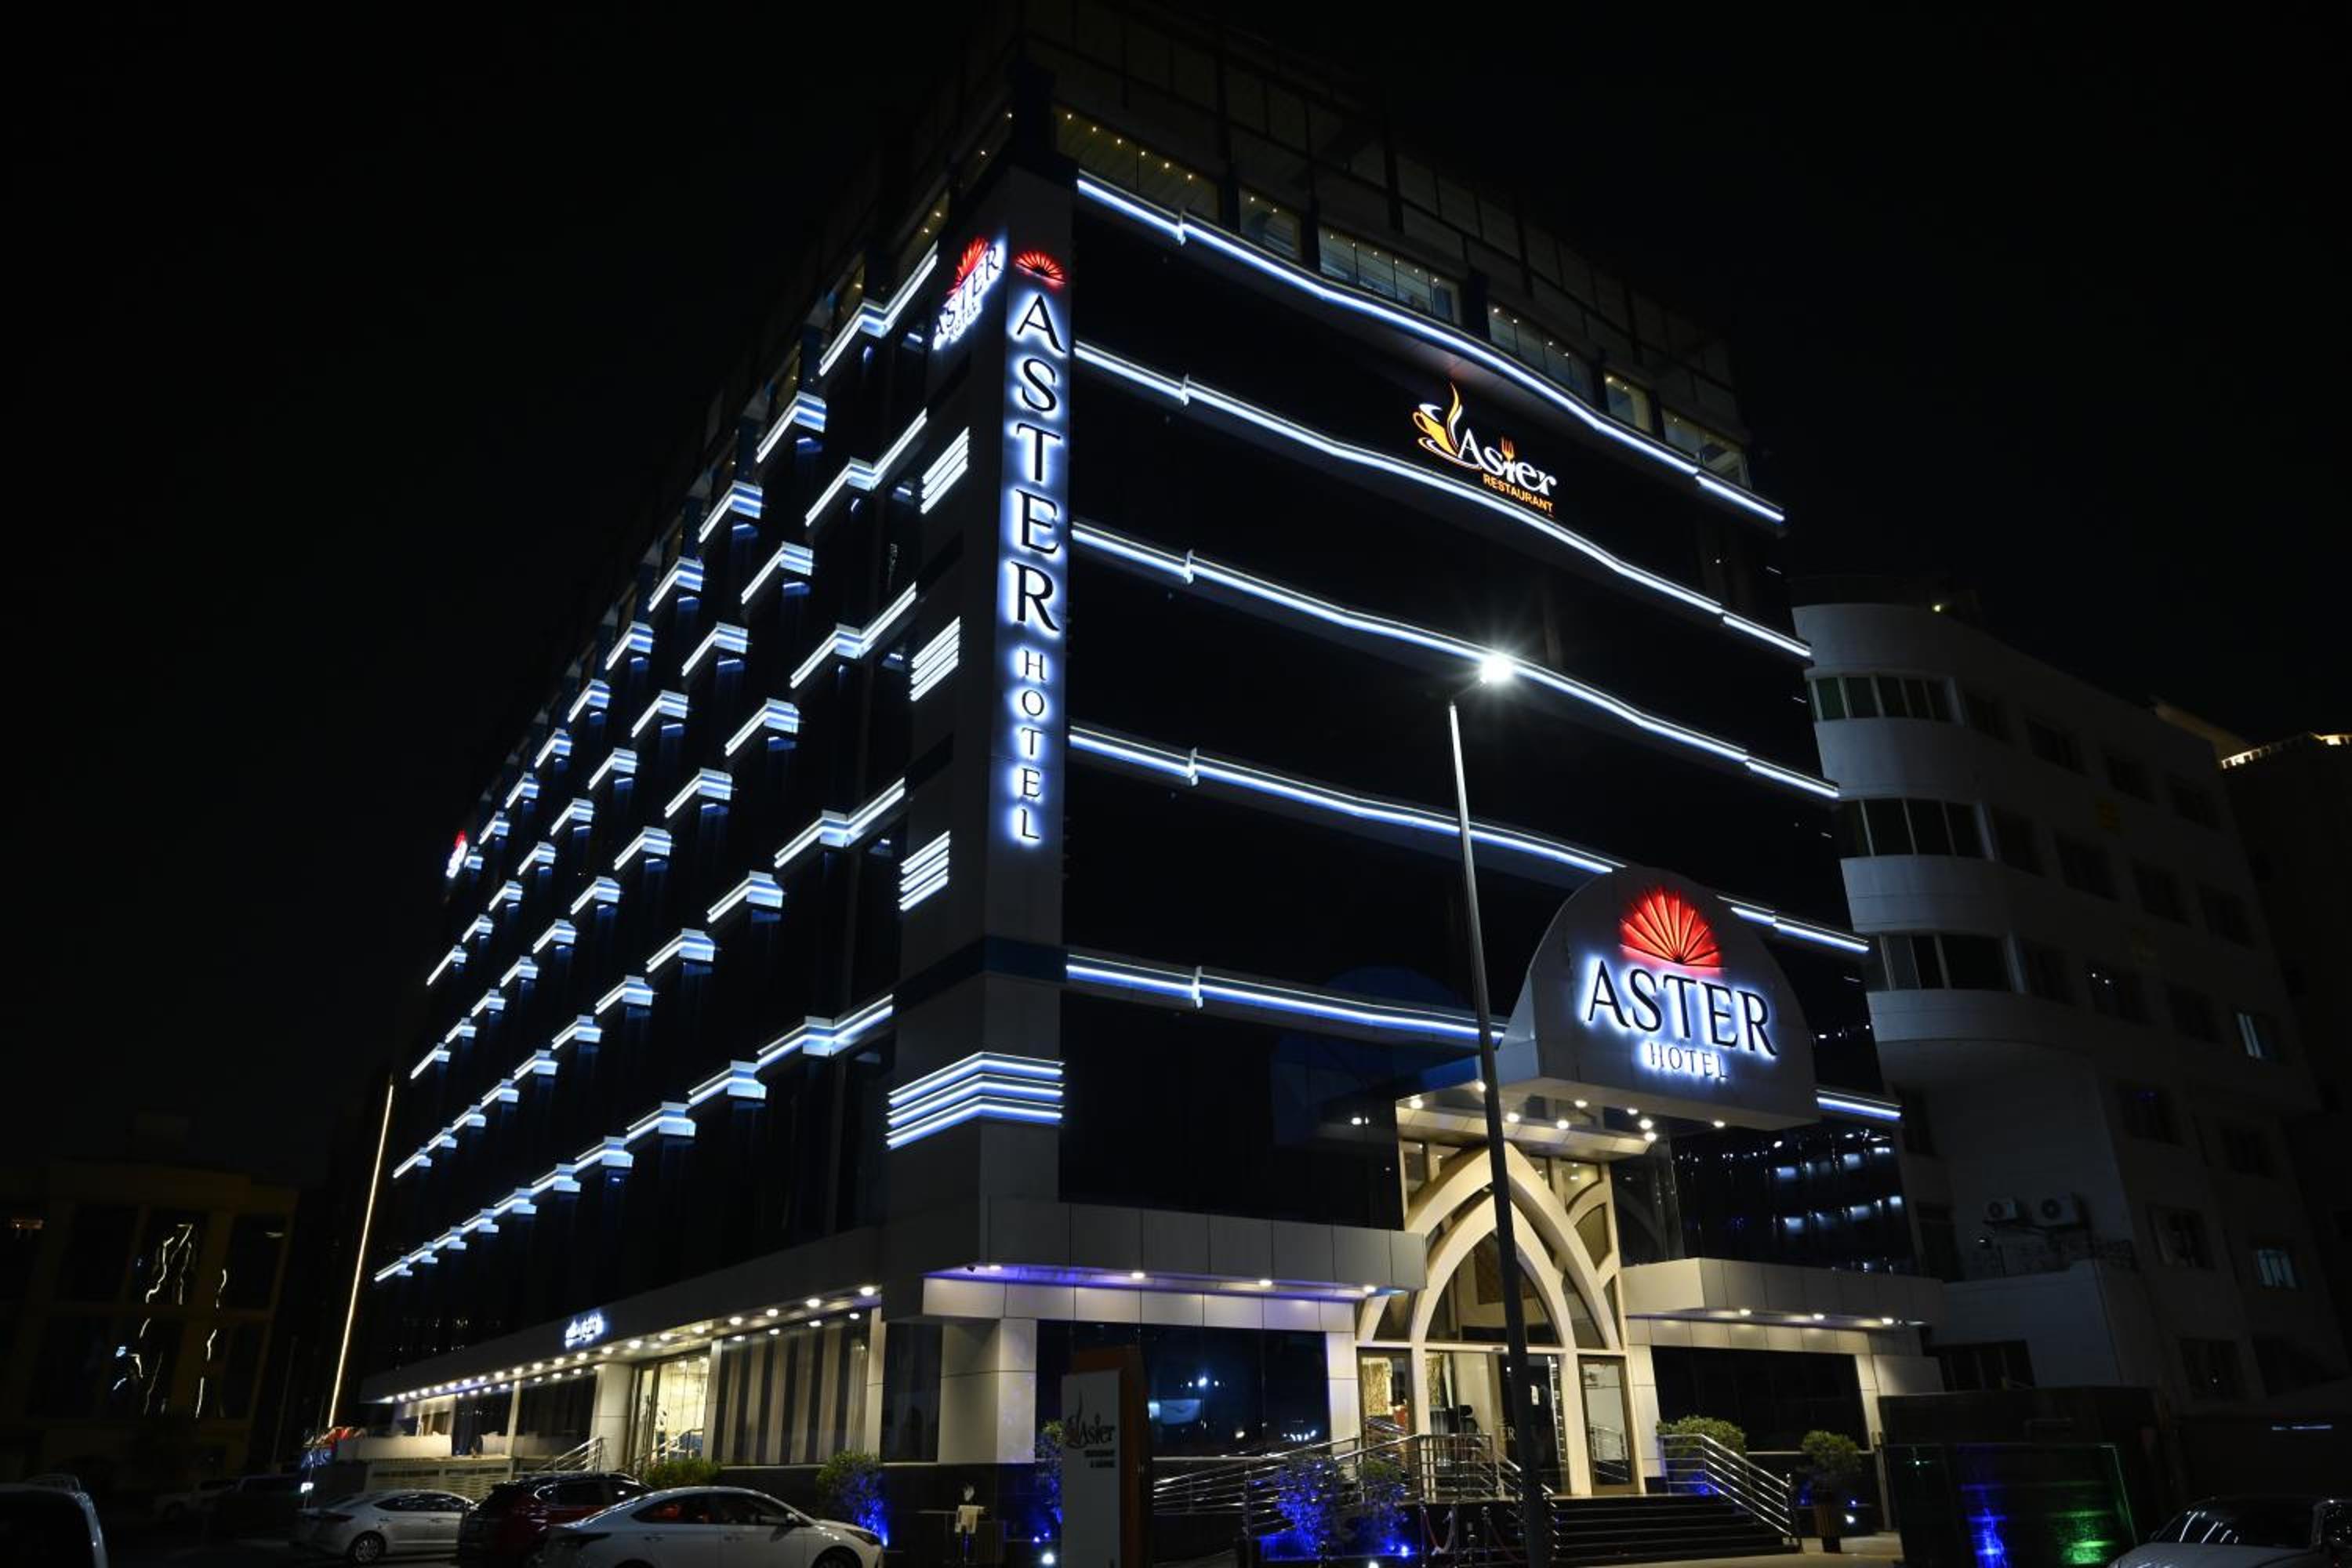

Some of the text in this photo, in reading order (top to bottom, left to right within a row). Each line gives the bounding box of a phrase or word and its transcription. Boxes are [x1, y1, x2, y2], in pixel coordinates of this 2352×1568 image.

[1457, 428, 1558, 495] Aster
[1483, 473, 1555, 513] RESTAURANT
[1011, 295, 1065, 840] ASTER HOTEL
[1588, 960, 1778, 1056] ASTER
[1650, 1042, 1728, 1079] HOTEL
